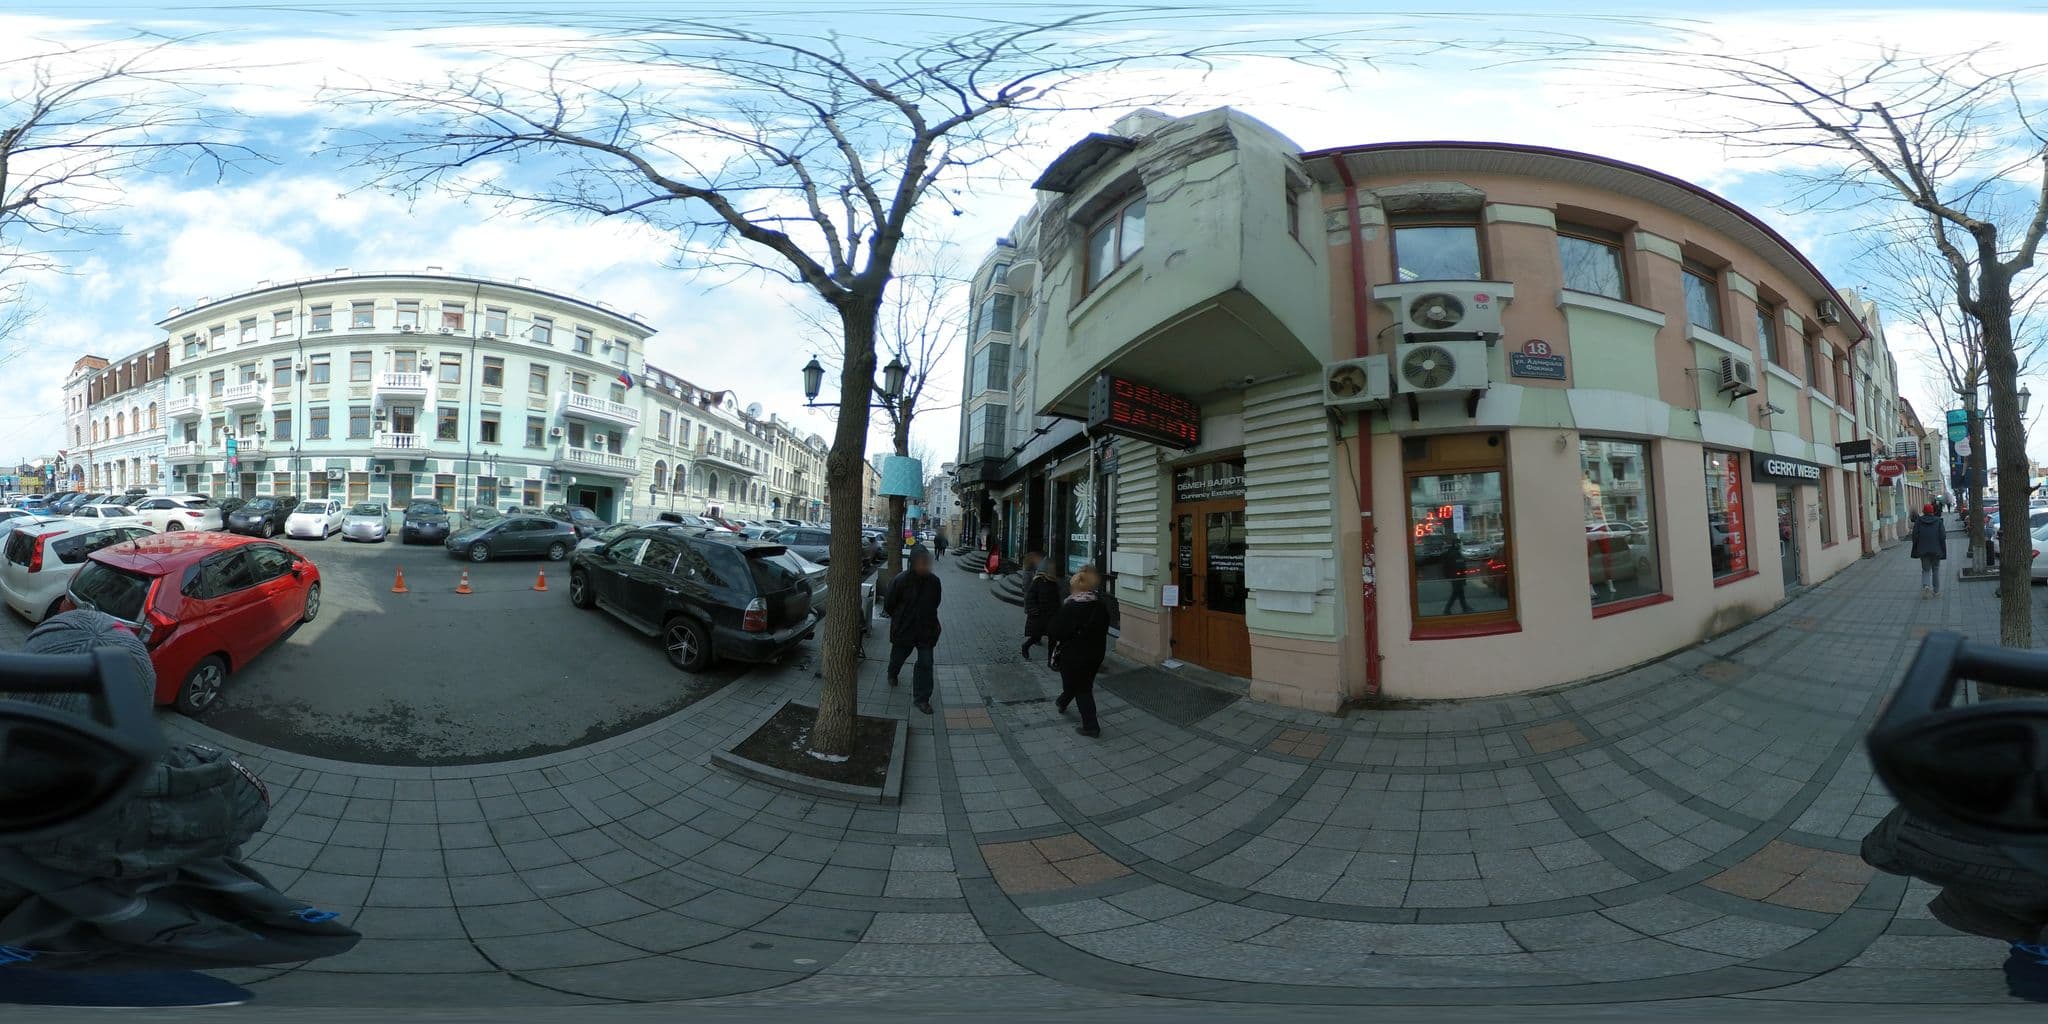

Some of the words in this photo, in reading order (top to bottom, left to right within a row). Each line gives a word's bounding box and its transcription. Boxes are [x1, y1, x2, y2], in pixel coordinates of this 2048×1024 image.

[1528, 342, 1547, 355] 18
[1767, 459, 1797, 477] GERRY
[1797, 463, 1820, 480] WEBER
[1177, 481, 1206, 491] ОБМЕН
[1729, 471, 1741, 544] SALE
